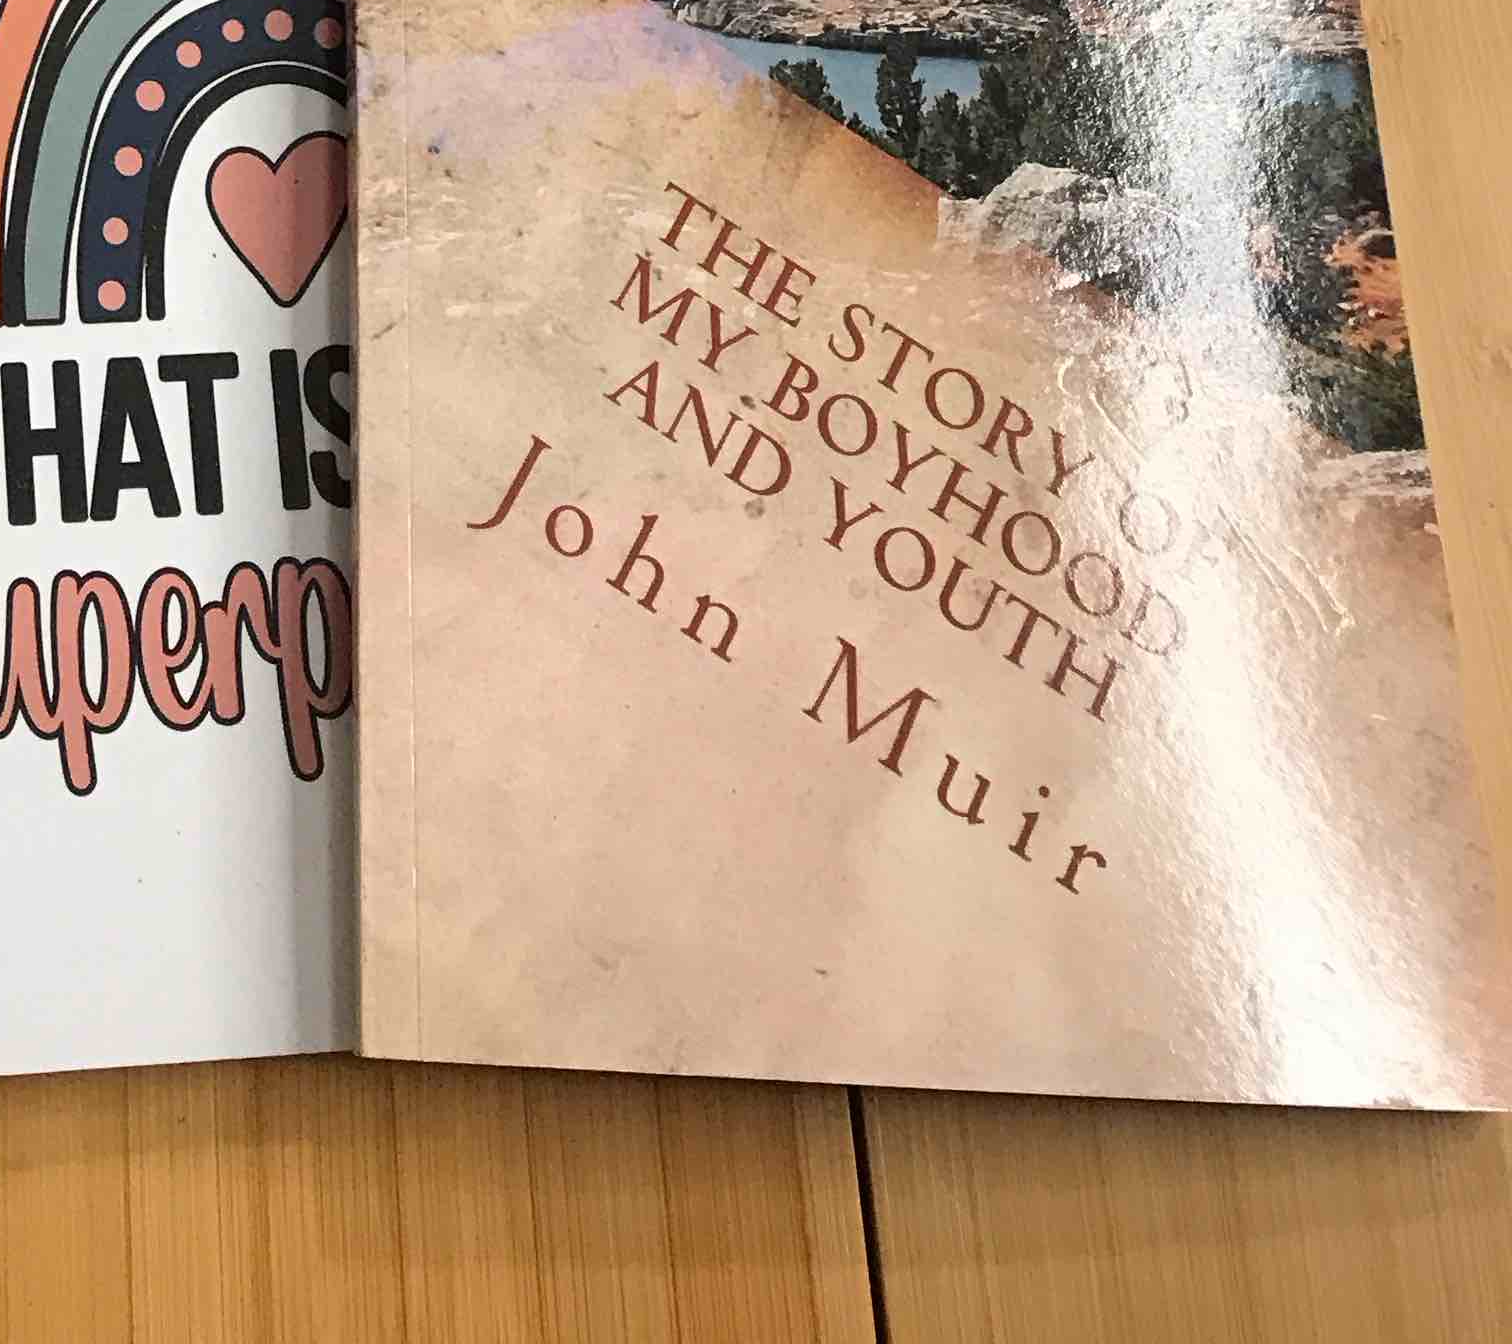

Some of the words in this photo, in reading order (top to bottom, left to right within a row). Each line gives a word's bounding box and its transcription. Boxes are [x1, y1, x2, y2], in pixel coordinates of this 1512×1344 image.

[269, 345, 353, 512] IS
[610, 254, 760, 373] MY
[762, 354, 1189, 656] BOYHOOD
[659, 182, 817, 329] THE
[829, 303, 1096, 499] STORY
[466, 434, 742, 664] John
[802, 636, 1109, 895] Muir
[603, 360, 793, 498] AND
[822, 475, 1126, 722] YOUTH
